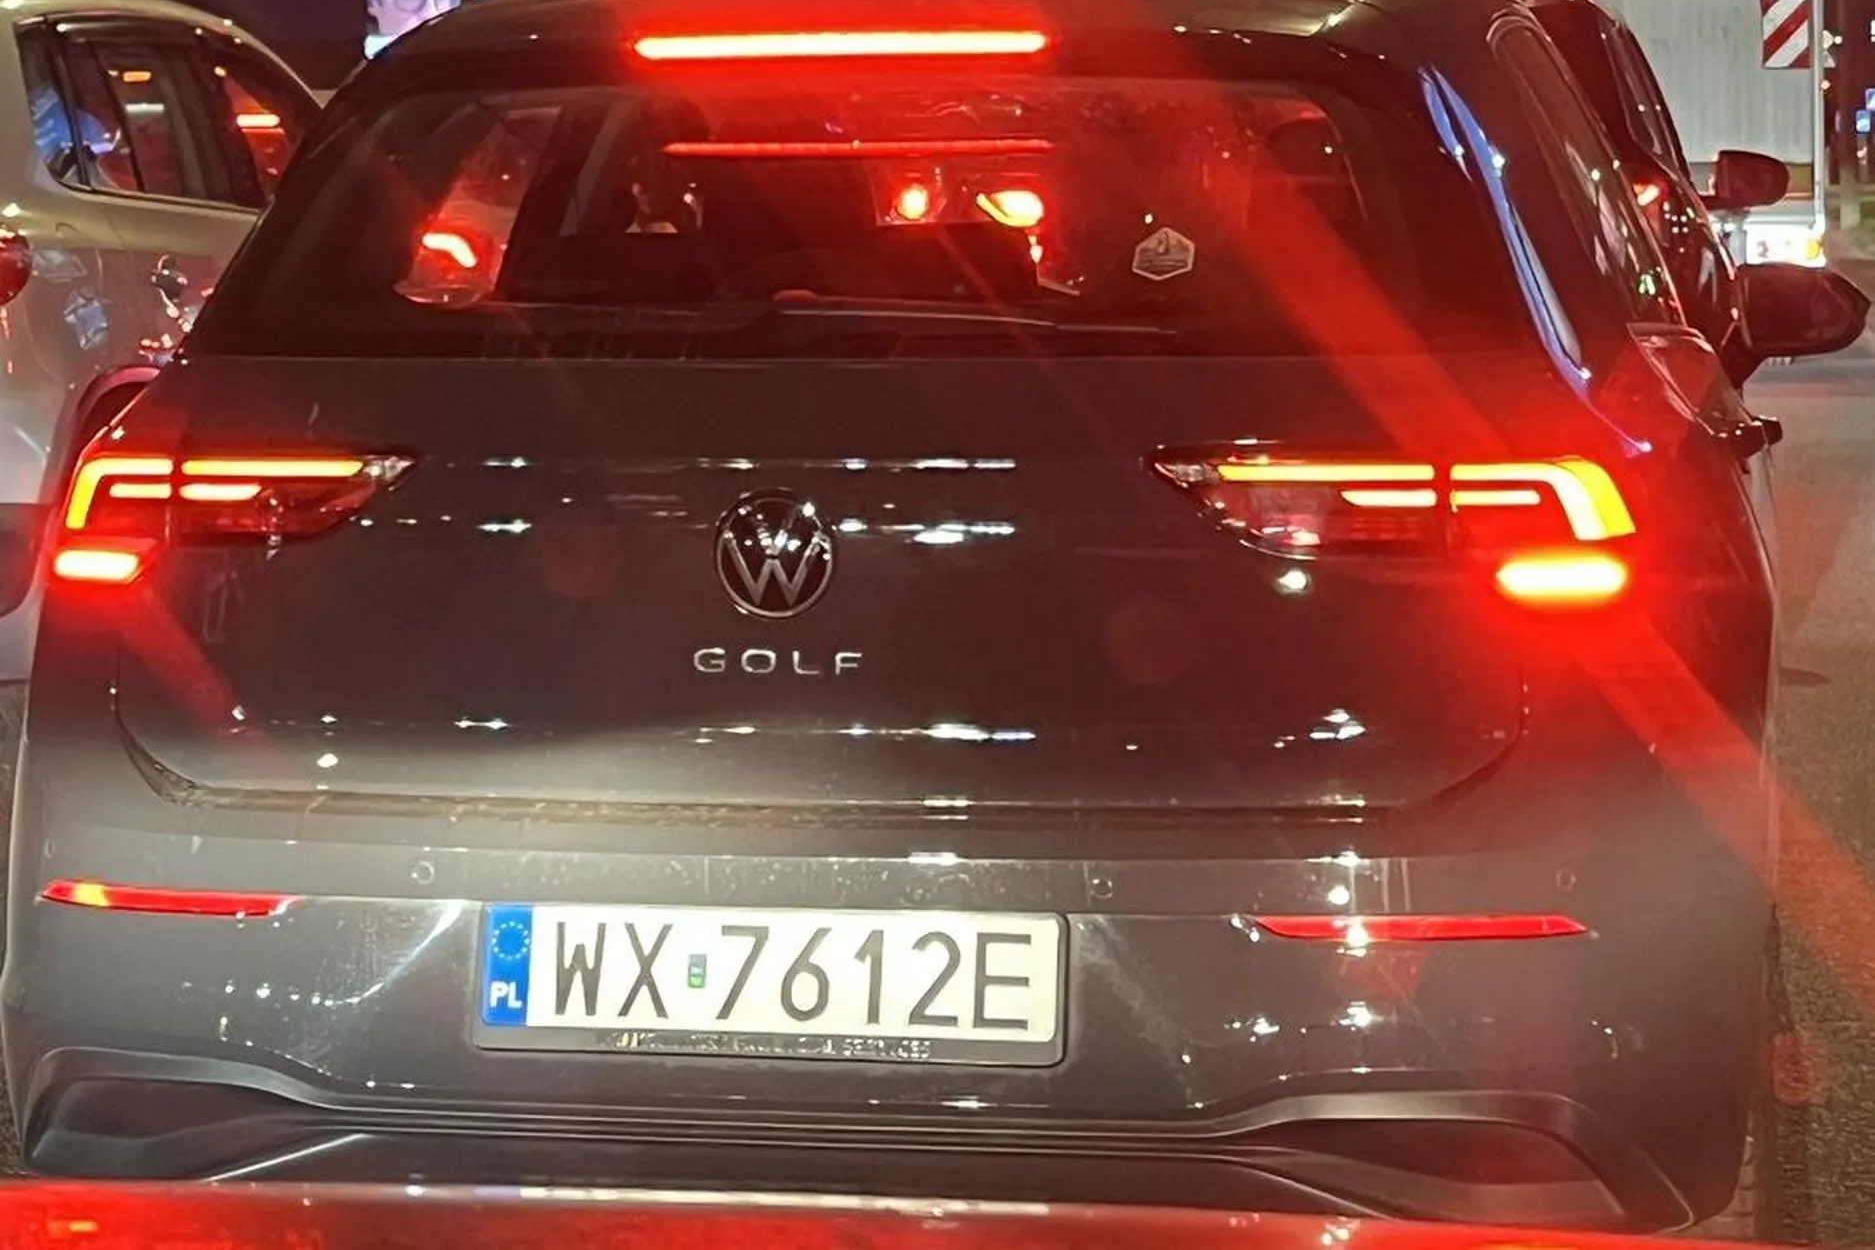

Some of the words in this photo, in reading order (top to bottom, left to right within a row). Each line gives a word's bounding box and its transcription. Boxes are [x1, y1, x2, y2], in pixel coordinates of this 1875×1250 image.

[693, 647, 862, 674] GOLF
[555, 921, 674, 1020] WX
[715, 924, 1033, 1031] 7612E
[490, 980, 523, 1009] PL
